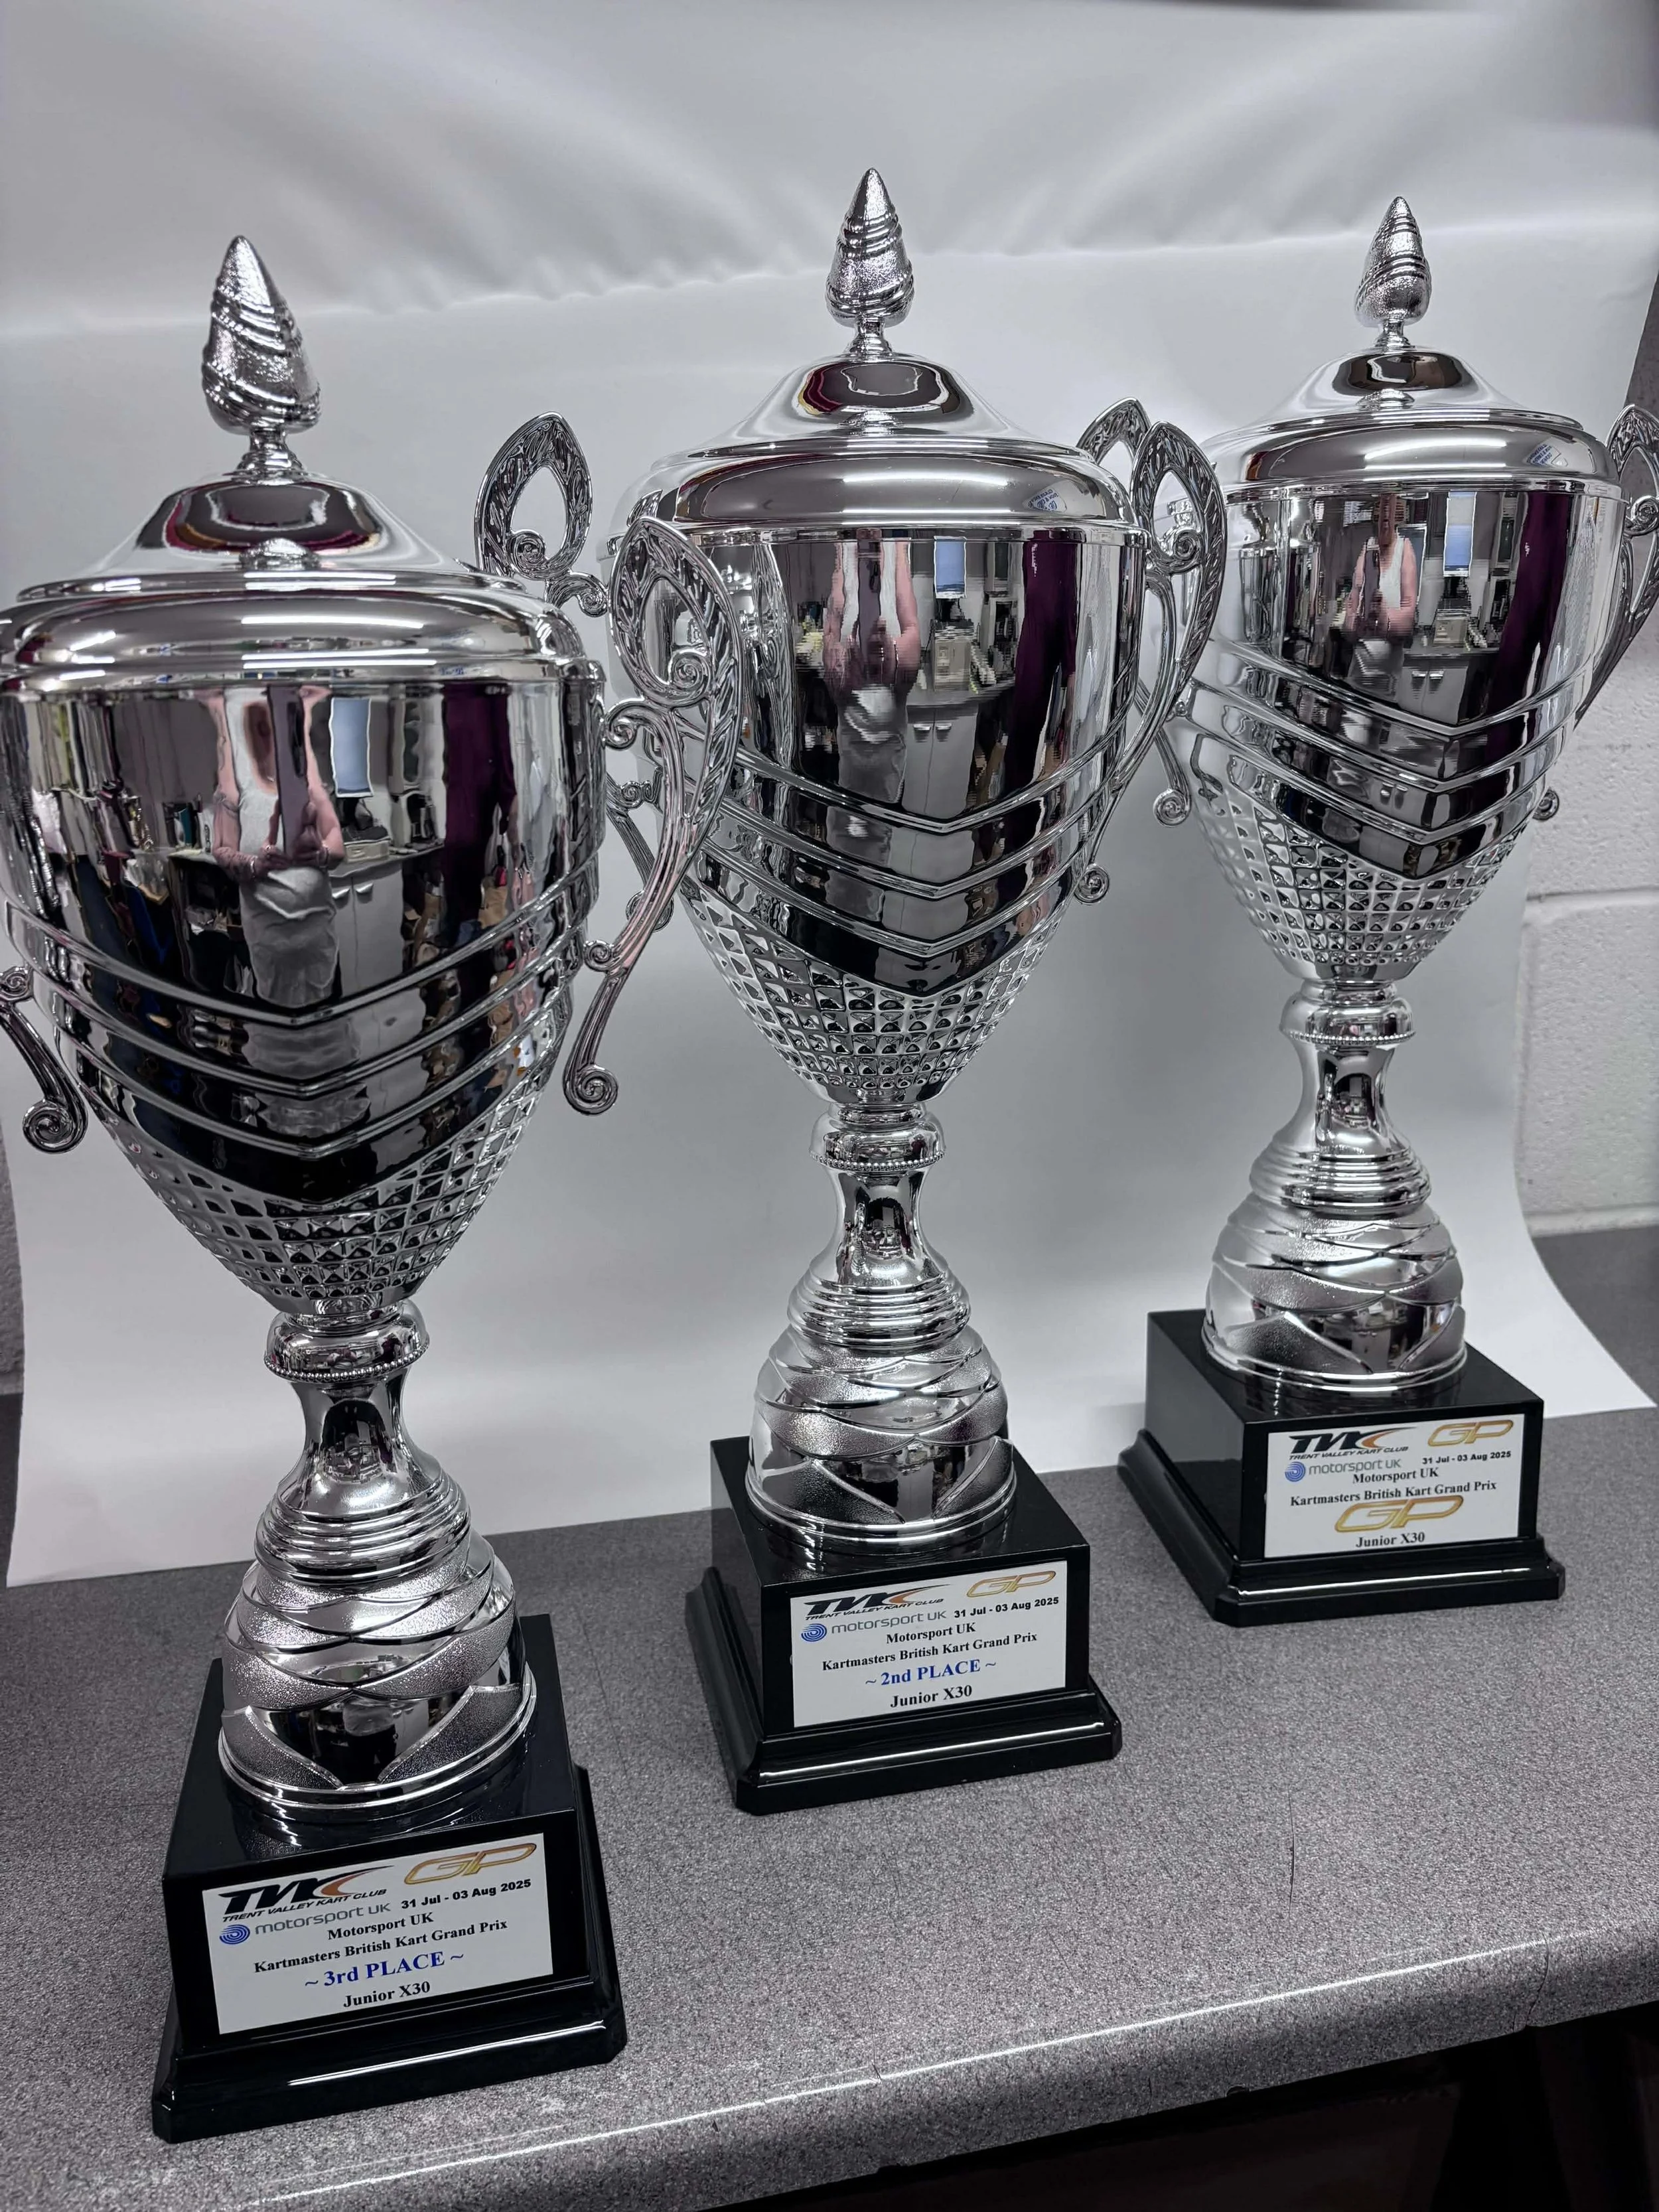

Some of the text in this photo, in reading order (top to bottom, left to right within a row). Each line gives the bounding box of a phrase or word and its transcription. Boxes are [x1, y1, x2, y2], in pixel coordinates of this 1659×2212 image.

[1309, 1459, 1401, 1475] motorsport UK
[1471, 1453, 1487, 1461] Aug
[1352, 1468, 1439, 1483] Motorsport UK
[1291, 1481, 1496, 1506] Kartmasters British Kart Grand Prix
[1356, 1532, 1425, 1547] Junior X30
[843, 1606, 883, 1615] VALLEY
[954, 1609, 966, 1618] 31
[970, 1607, 986, 1617] Jul
[995, 1604, 1008, 1613] 03
[1011, 1601, 1031, 1612] Aug
[1035, 1597, 1058, 1607] 2025
[831, 1610, 946, 1634] motorsport UK
[886, 1623, 976, 1644] Motorsport UK
[822, 1632, 1037, 1671] Kartmasters British Kart Grand Prix
[881, 1669, 911, 1686] 2nd
[917, 1659, 981, 1680] PLACE
[890, 1684, 972, 1708] Junior X30
[222, 1889, 386, 1923] TRENT VALLEY KART CLUB
[401, 1897, 417, 1909] 31
[421, 1893, 441, 1907] Jul
[453, 1890, 469, 1901] 03
[472, 1885, 496, 1899] Aug
[501, 1879, 531, 1892] 2025
[255, 1903, 391, 1935] motorsport UK
[328, 1912, 434, 1941] Motorsport UK
[255, 1919, 508, 1973] Kartmasters British Kart Grand Prix
[324, 1967, 360, 1987] 3rd
[366, 1951, 445, 1979] PLACE
[343, 1981, 431, 2008] Junior X30
